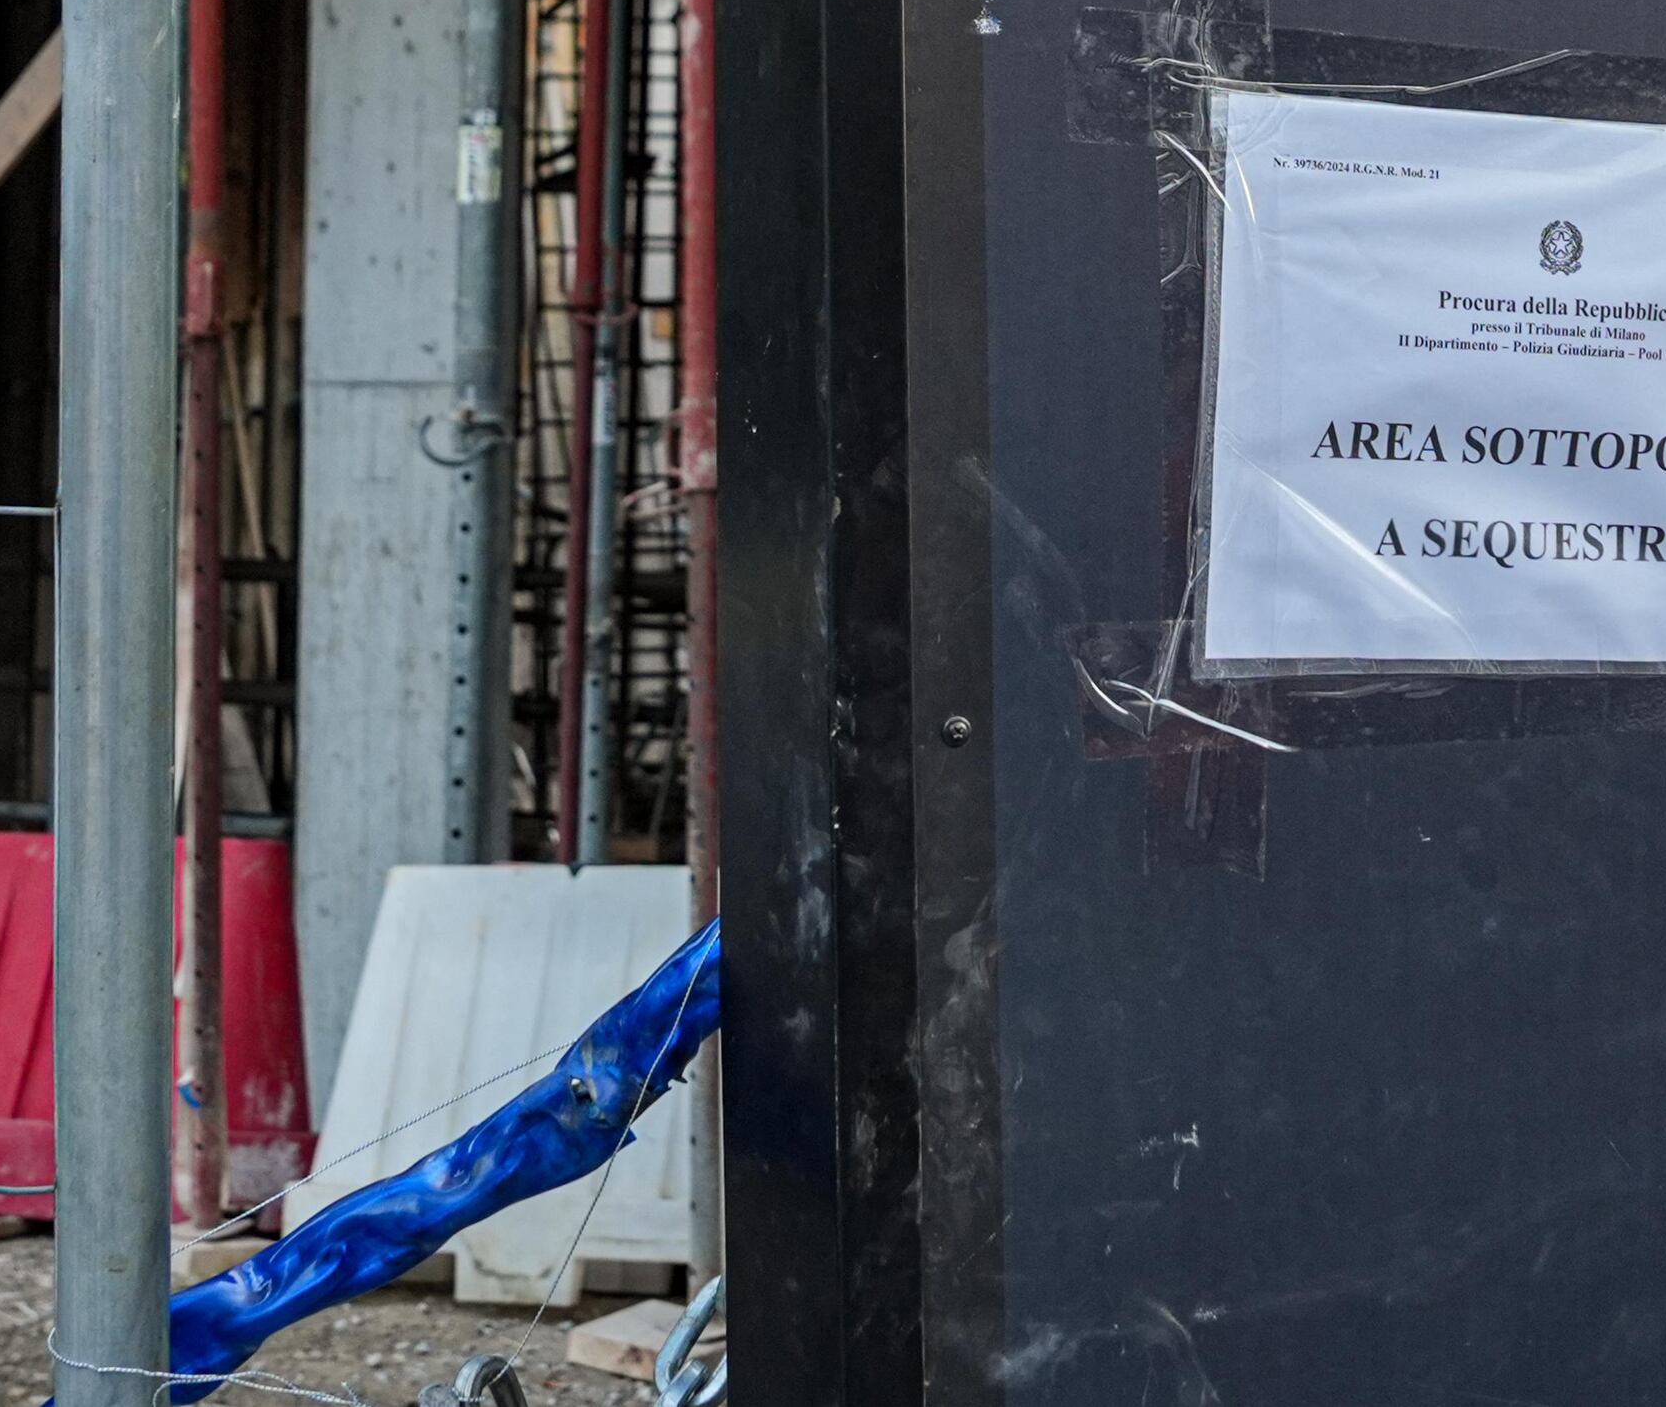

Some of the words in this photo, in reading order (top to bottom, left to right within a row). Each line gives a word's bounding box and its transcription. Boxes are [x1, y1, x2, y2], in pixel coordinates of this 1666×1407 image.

[1273, 157, 1290, 169] Nr.
[1294, 159, 1350, 173] 39736/2024
[1353, 164, 1397, 176] R.G.N.R.
[1401, 167, 1426, 179] Mod.
[1429, 169, 1440, 179] 21
[1438, 290, 1516, 312] Procura
[1523, 296, 1568, 316] della
[1472, 322, 1511, 335] presso
[1515, 322, 1522, 334] il
[1526, 323, 1586, 338] Tribunale
[1590, 326, 1602, 339] di
[1605, 327, 1646, 341] Milano
[1398, 334, 1410, 347] II
[1414, 335, 1498, 352] Dipartimento
[1513, 341, 1553, 355] Polizia
[1557, 344, 1625, 358] Giudiziaria
[1638, 348, 1662, 361] Pool
[1310, 421, 1445, 464] AREA
[1375, 519, 1406, 558] A
